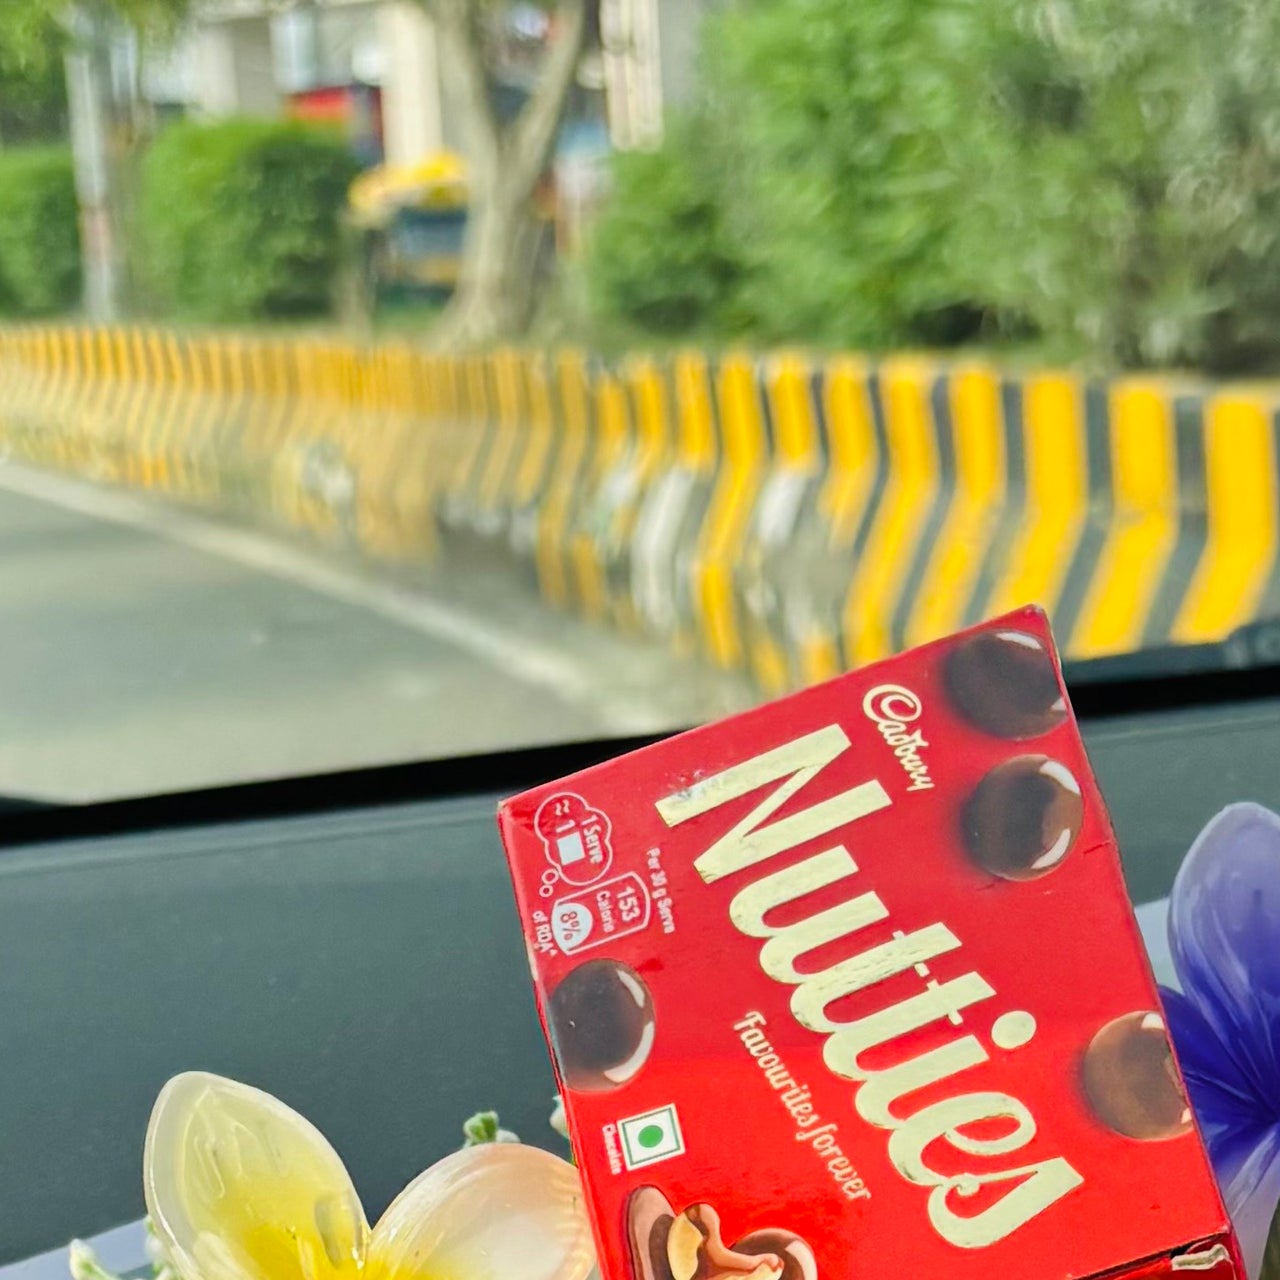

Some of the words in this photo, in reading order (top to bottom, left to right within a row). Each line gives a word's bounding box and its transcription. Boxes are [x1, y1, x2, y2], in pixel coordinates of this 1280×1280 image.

[862, 683, 937, 792] Cadbury
[583, 825, 603, 865] Serve
[559, 911, 583, 942] 8%
[617, 886, 641, 922] 153
[654, 723, 1085, 1249] Nutties
[734, 1011, 819, 1130] Favourites
[796, 1122, 871, 1201] forever
